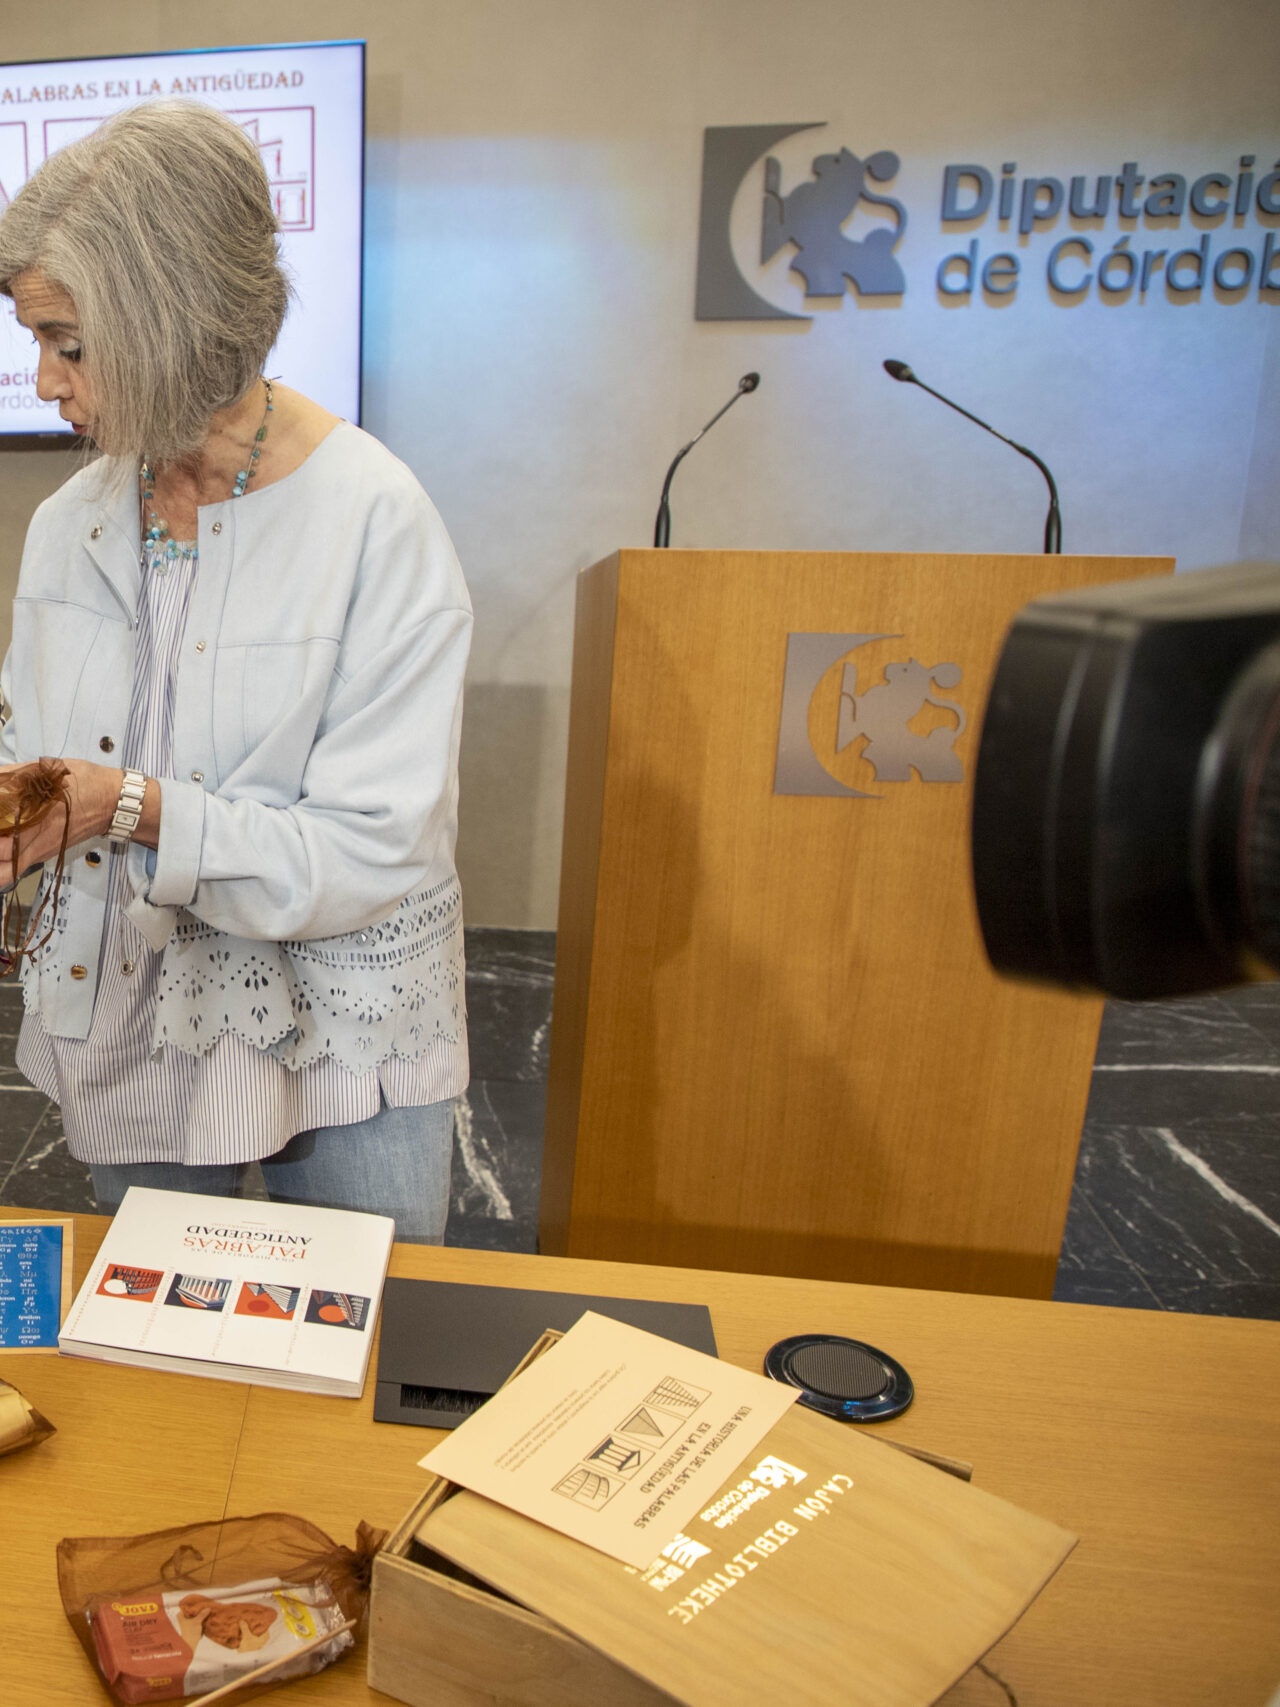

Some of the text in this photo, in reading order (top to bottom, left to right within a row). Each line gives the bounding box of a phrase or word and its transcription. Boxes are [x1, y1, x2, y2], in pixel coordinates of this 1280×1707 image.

[104, 80, 130, 98] EN
[136, 78, 161, 96] LA
[170, 69, 304, 93] ANTIGÜEDAD
[941, 154, 1280, 235] Diputació
[936, 233, 1280, 294] de Córdob
[184, 1236, 306, 1260] PALABRAS
[686, 1432, 702, 1445] LA
[696, 1421, 712, 1435] EN
[633, 1405, 753, 1529] UNA HISTORIA DE LAS PALABRAS
[699, 1479, 754, 1522] de Córdoba
[713, 1485, 771, 1529] Diputación
[668, 1474, 854, 1625] CAJÓN BIBLIOTHEKE
[124, 1605, 156, 1614] JOVI
